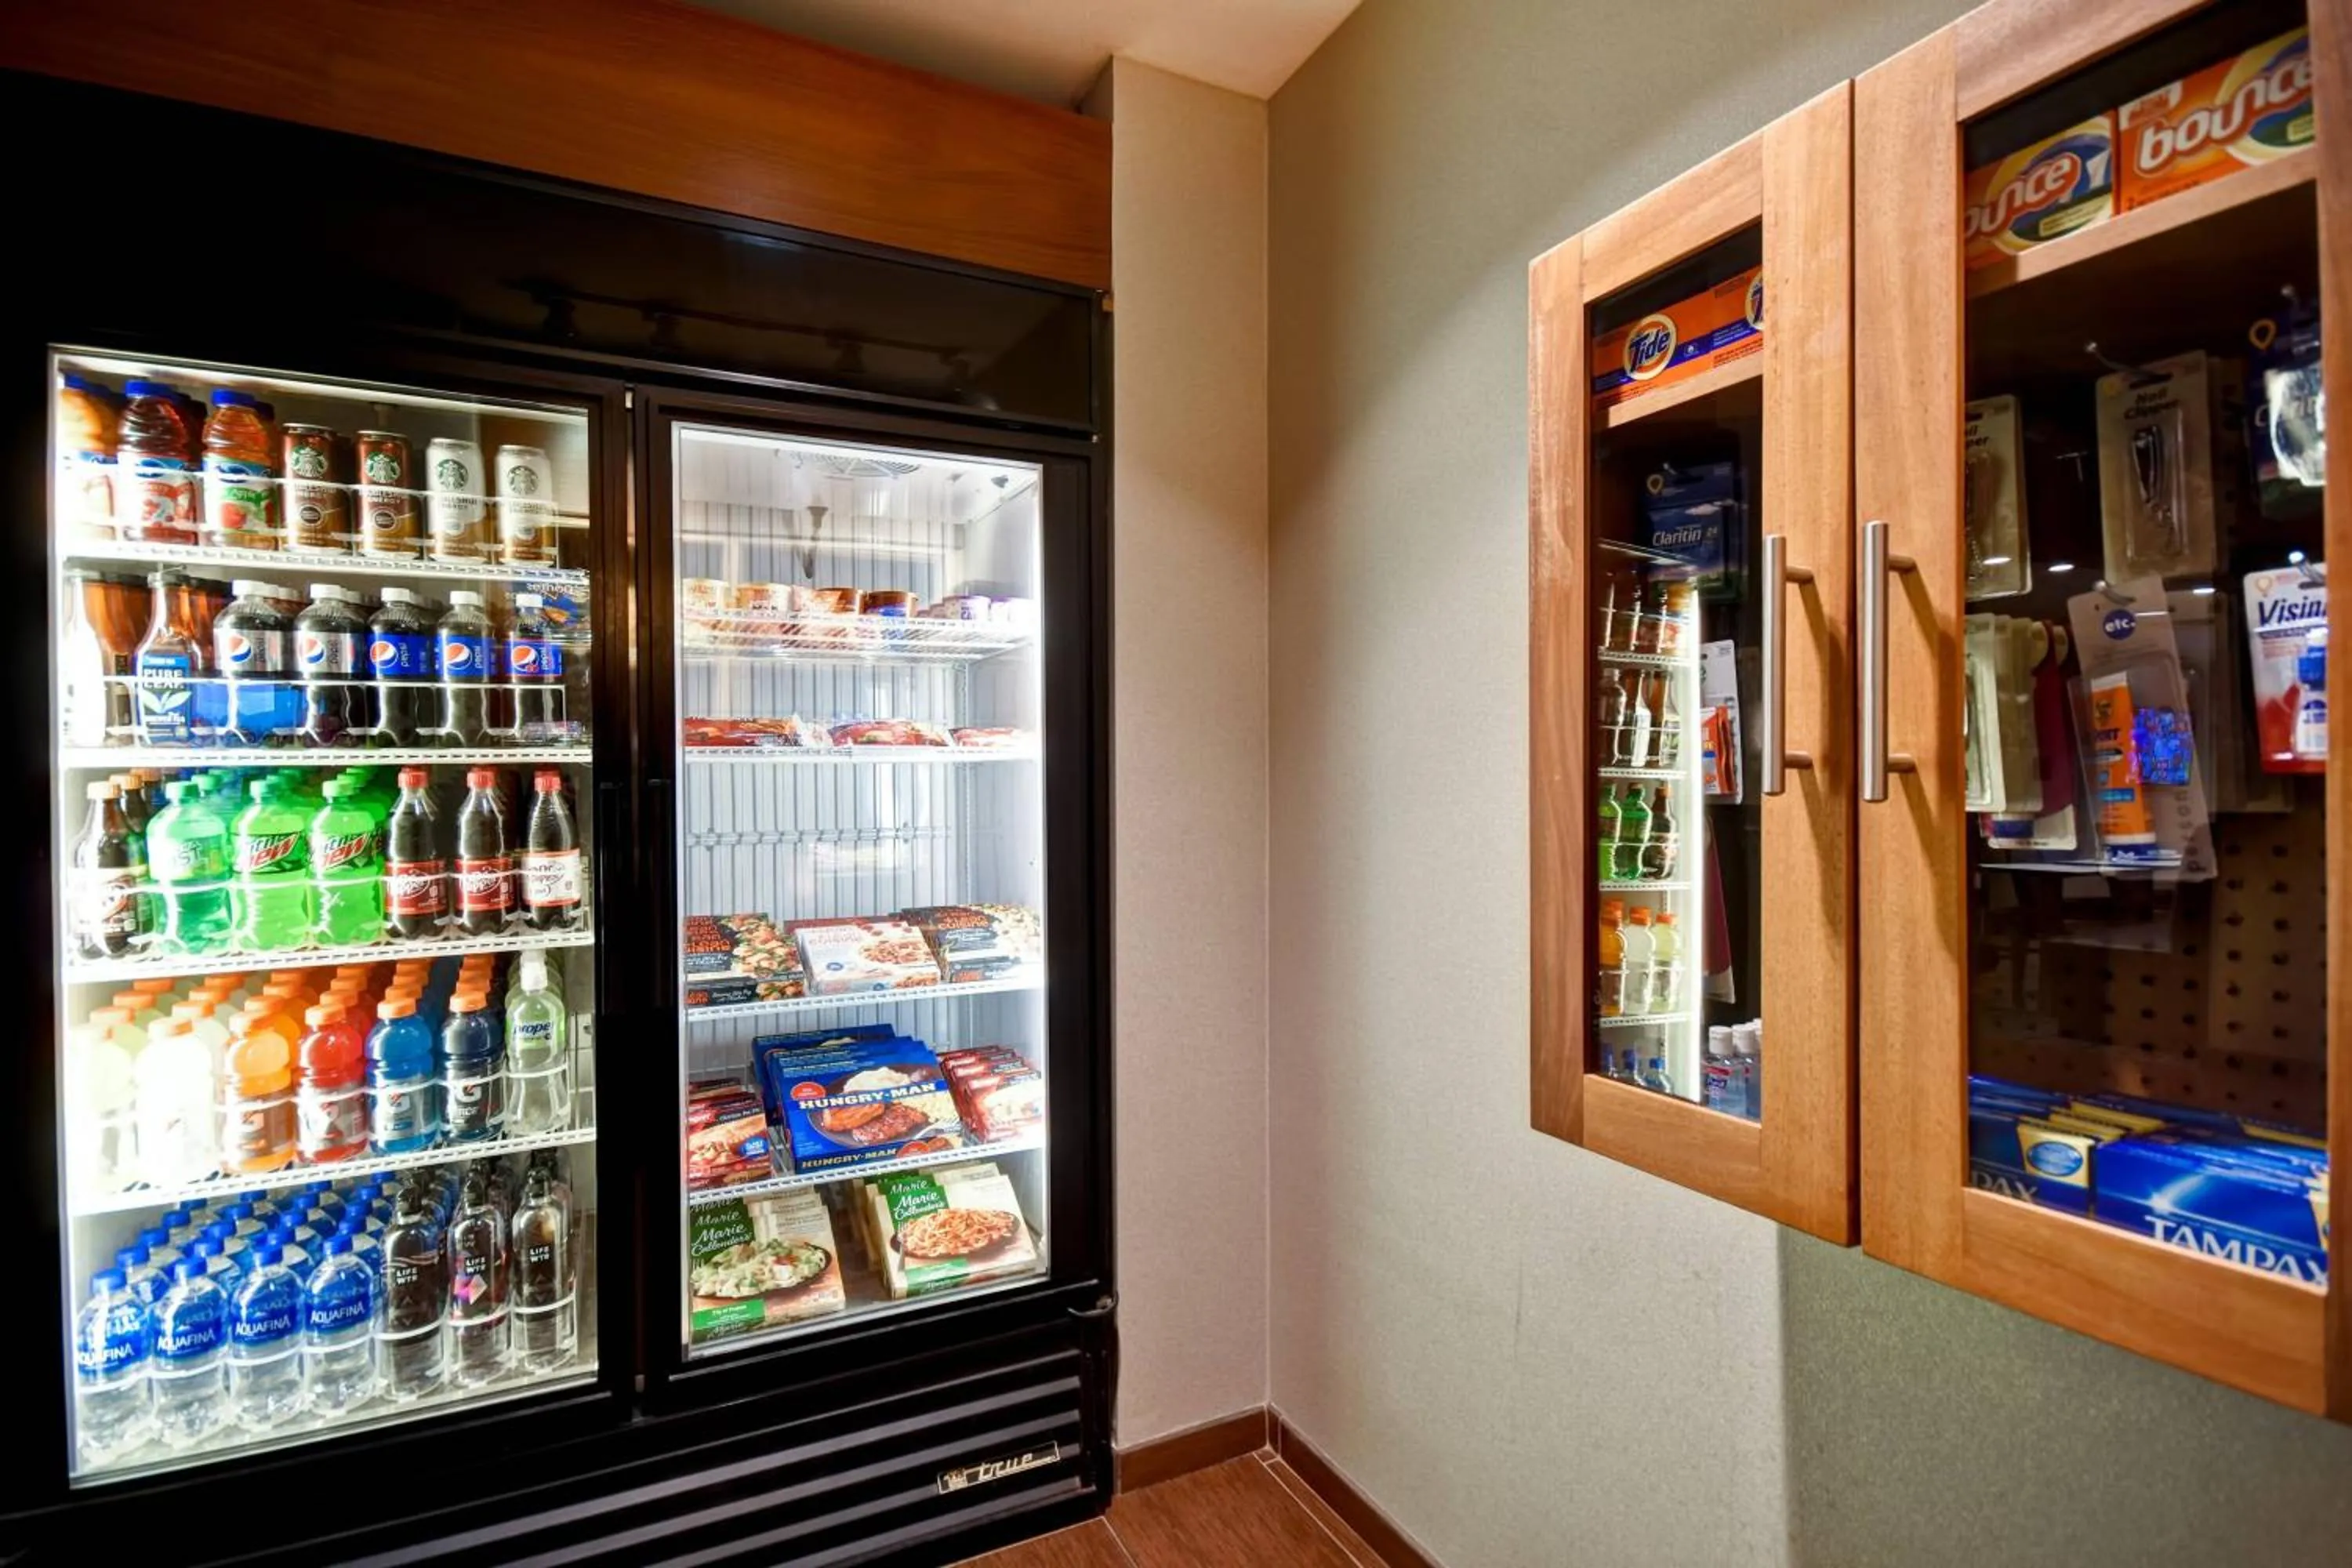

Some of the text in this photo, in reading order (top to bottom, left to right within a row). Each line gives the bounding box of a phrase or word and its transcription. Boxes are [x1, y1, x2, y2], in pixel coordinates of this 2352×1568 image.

[1965, 157, 2072, 238] ounce
[1628, 327, 1671, 373] Tide
[2134, 387, 2169, 405] Nail
[1652, 527, 1702, 546] Claritin
[2258, 596, 2327, 626] Visin
[399, 641, 410, 667] pepsi
[474, 644, 483, 669] pepsi
[799, 1080, 935, 1109] HUNGRY-MAN
[801, 1148, 898, 1168] HUNGRY-MAN
[890, 1180, 929, 1195] Marie
[895, 1191, 940, 1210] Marie
[695, 1210, 740, 1227] Marie
[691, 1224, 746, 1245] Marie
[465, 1256, 487, 1267] LIFE
[529, 1245, 550, 1256] LIFE
[396, 1266, 418, 1277] LIFE
[310, 1301, 365, 1325] AQUAFINA
[235, 1314, 292, 1337] AQUAFINA
[157, 1327, 216, 1352] AQUAFINA
[980, 1452, 1033, 1481] true
